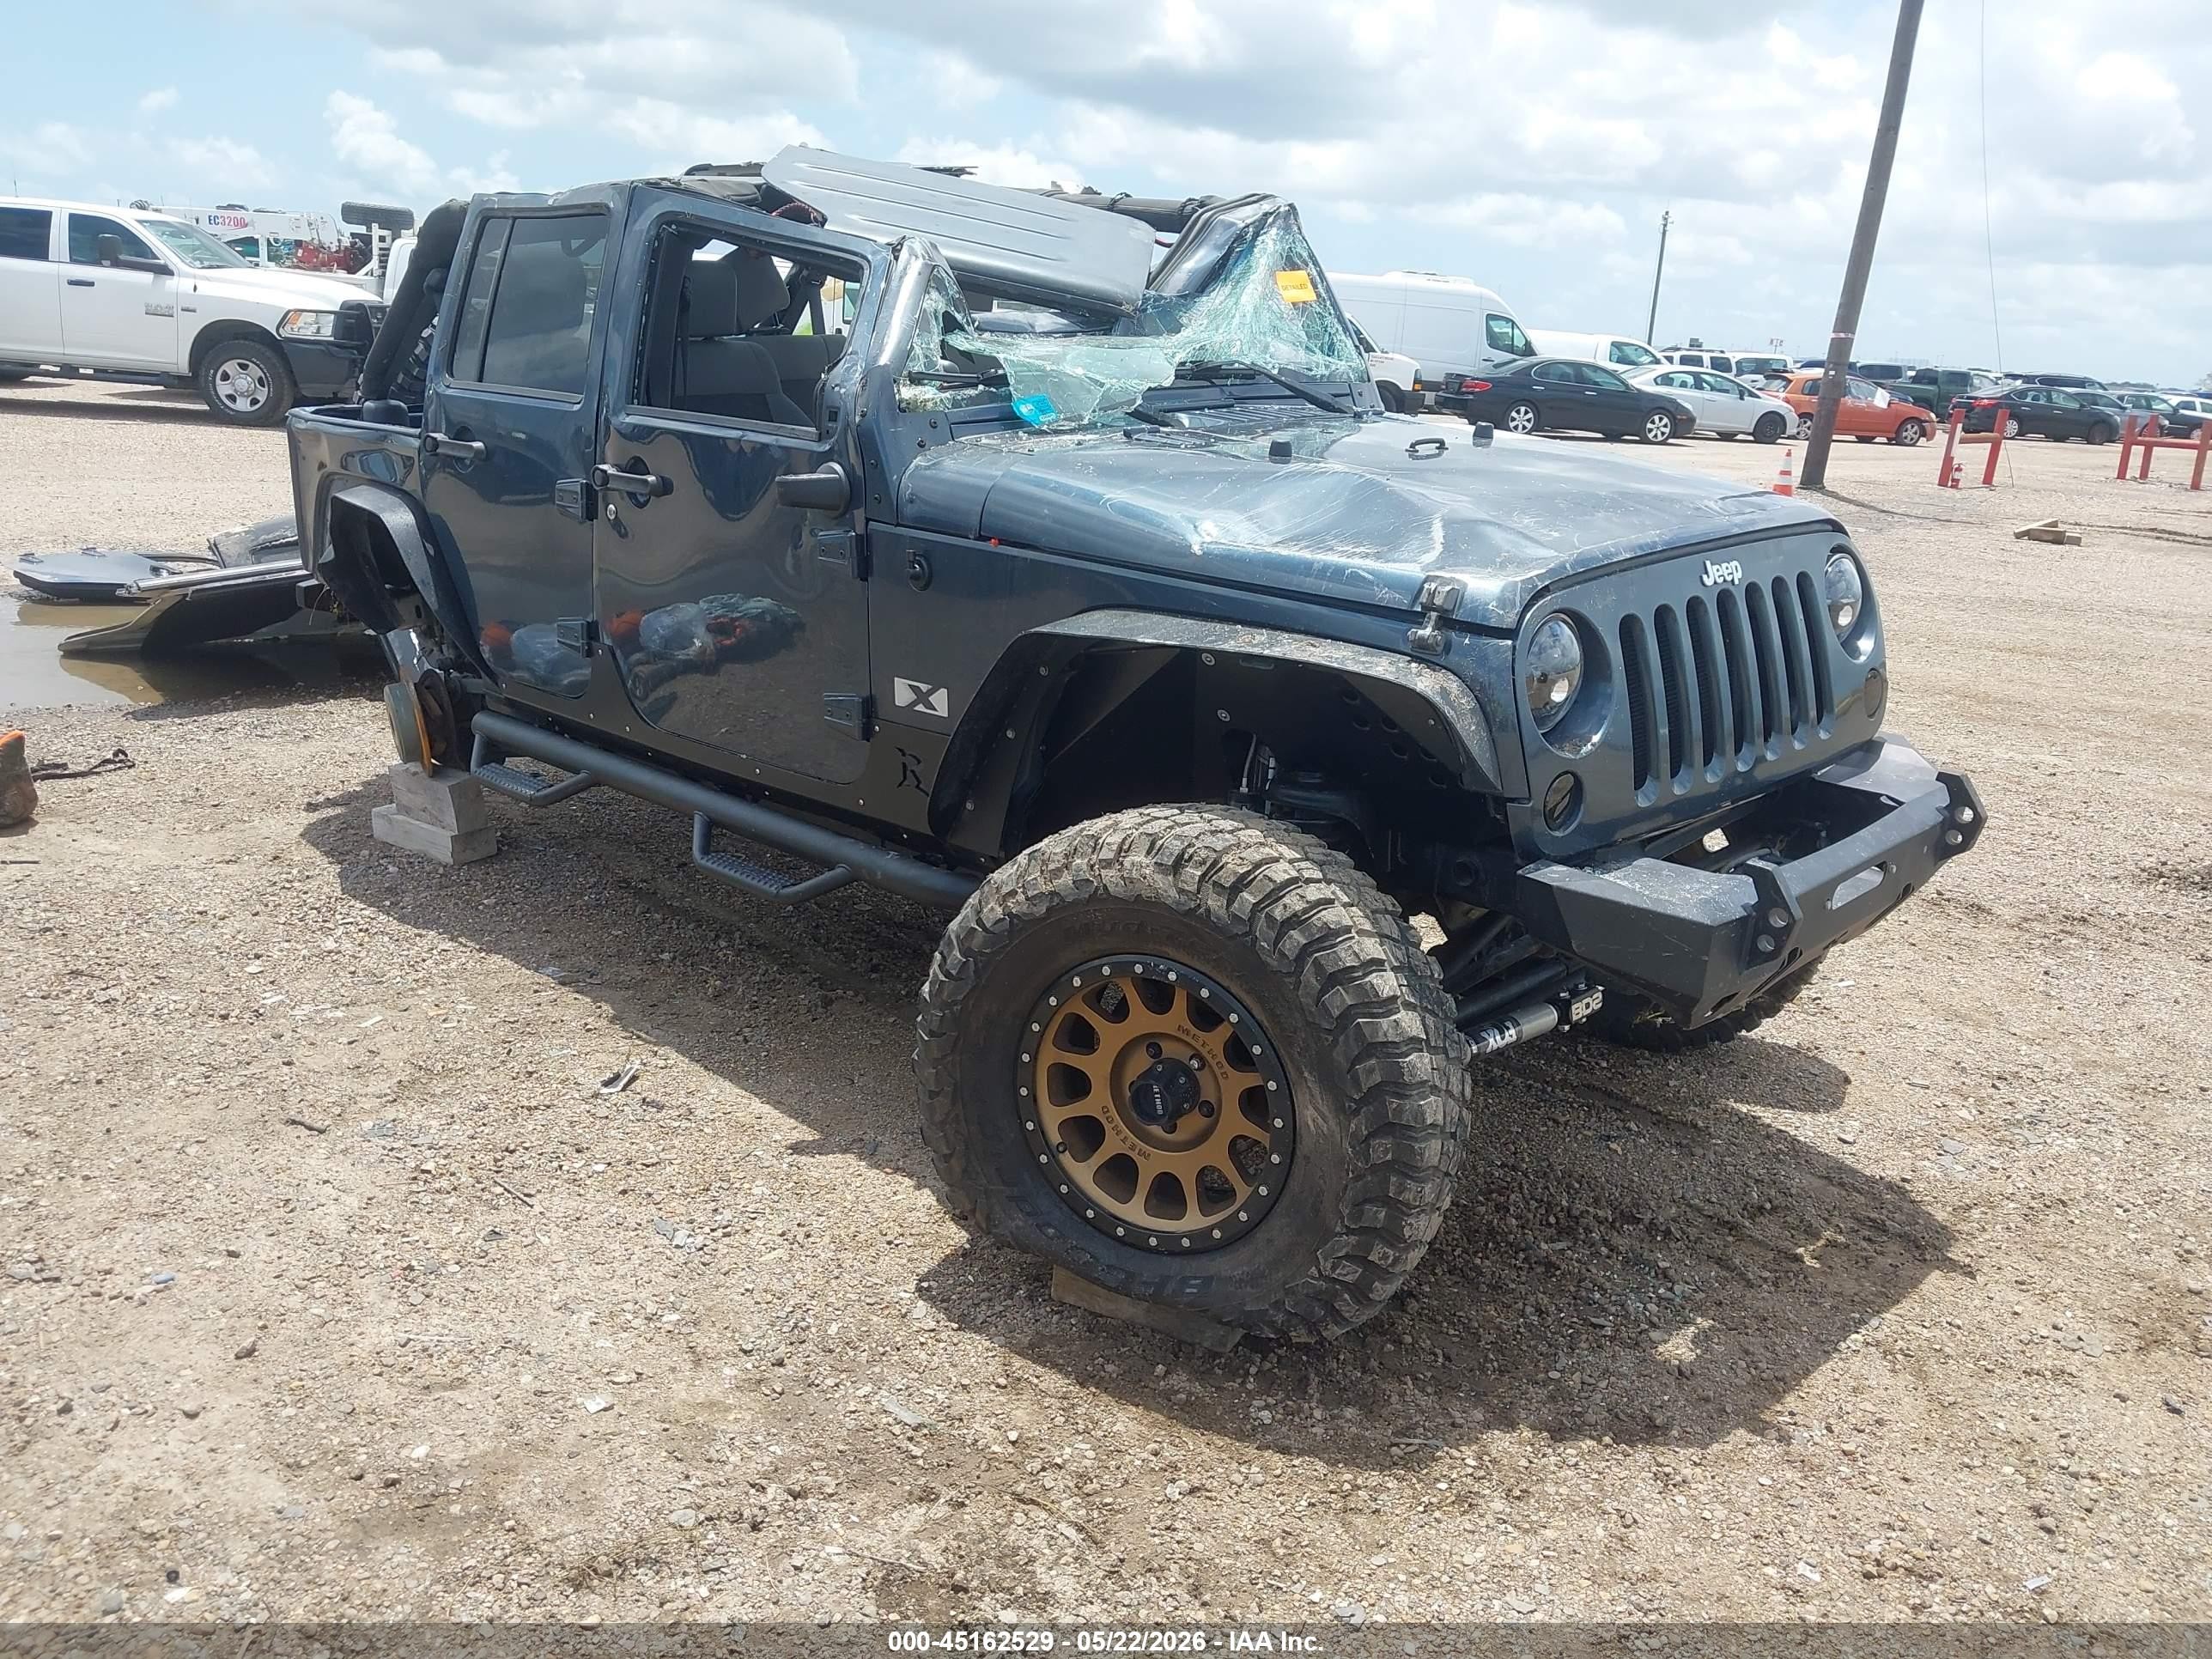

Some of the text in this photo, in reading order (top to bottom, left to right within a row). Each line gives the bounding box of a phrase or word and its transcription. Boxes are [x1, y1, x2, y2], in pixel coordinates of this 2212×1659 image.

[208, 215, 246, 228] EC3200
[1702, 560, 1742, 586] Jeep
[1176, 1024, 1229, 1080] METHOD
[1101, 1105, 1152, 1162] METHOD
